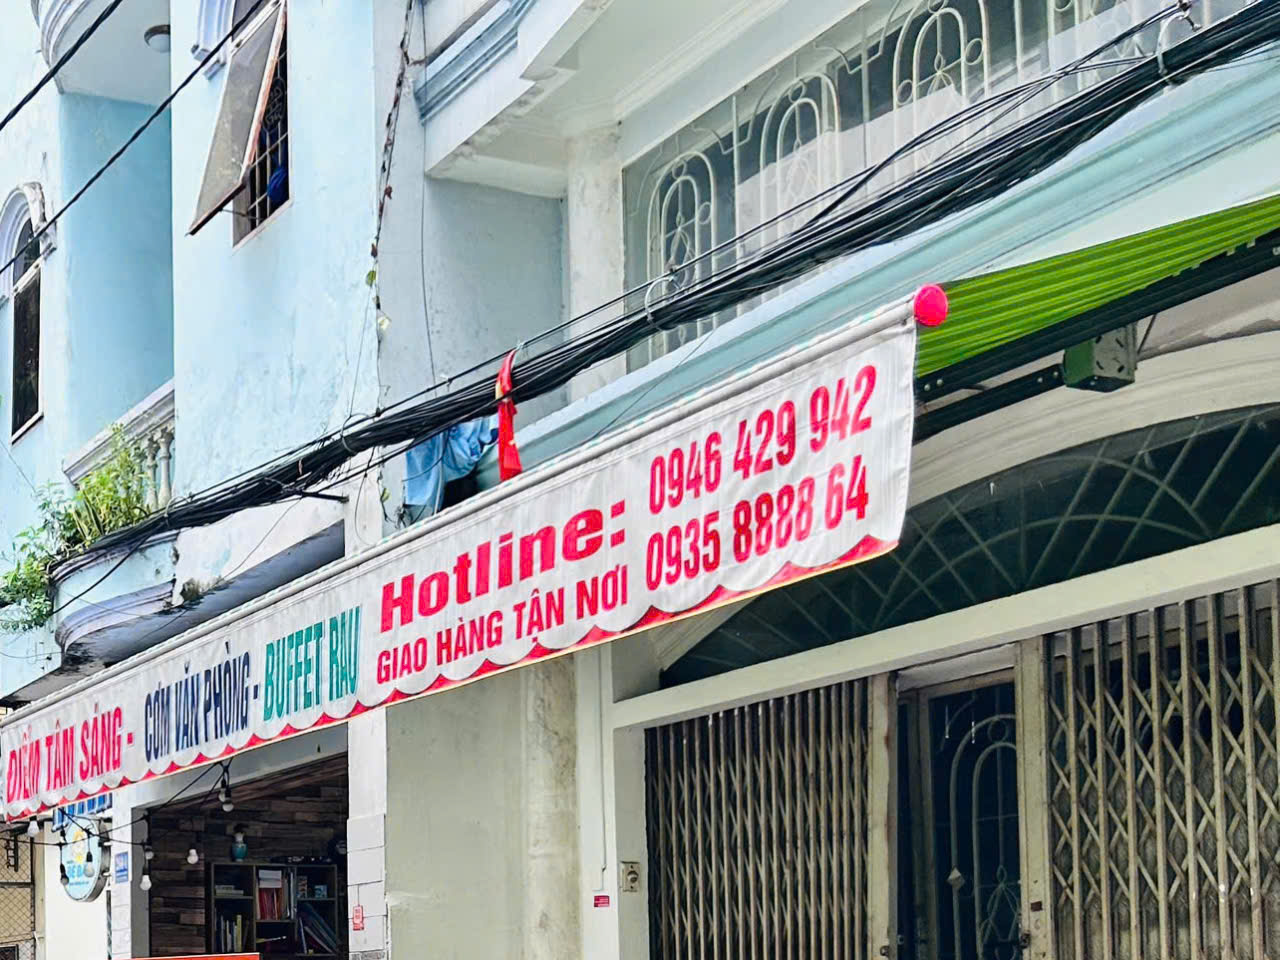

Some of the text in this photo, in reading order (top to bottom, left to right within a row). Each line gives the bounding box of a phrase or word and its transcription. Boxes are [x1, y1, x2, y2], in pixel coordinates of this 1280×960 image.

[376, 453, 871, 687] GIAO HÀNG TẬN NƠI 0935 8888 64
[380, 364, 878, 634] Hotline: 0946 429 942
[45, 717, 75, 788] TÂM
[79, 702, 123, 782] SÁNG
[144, 680, 172, 764] CƠM
[174, 660, 200, 753] VĂN
[203, 640, 250, 742] PHÒNG
[262, 621, 324, 722] BUFFET
